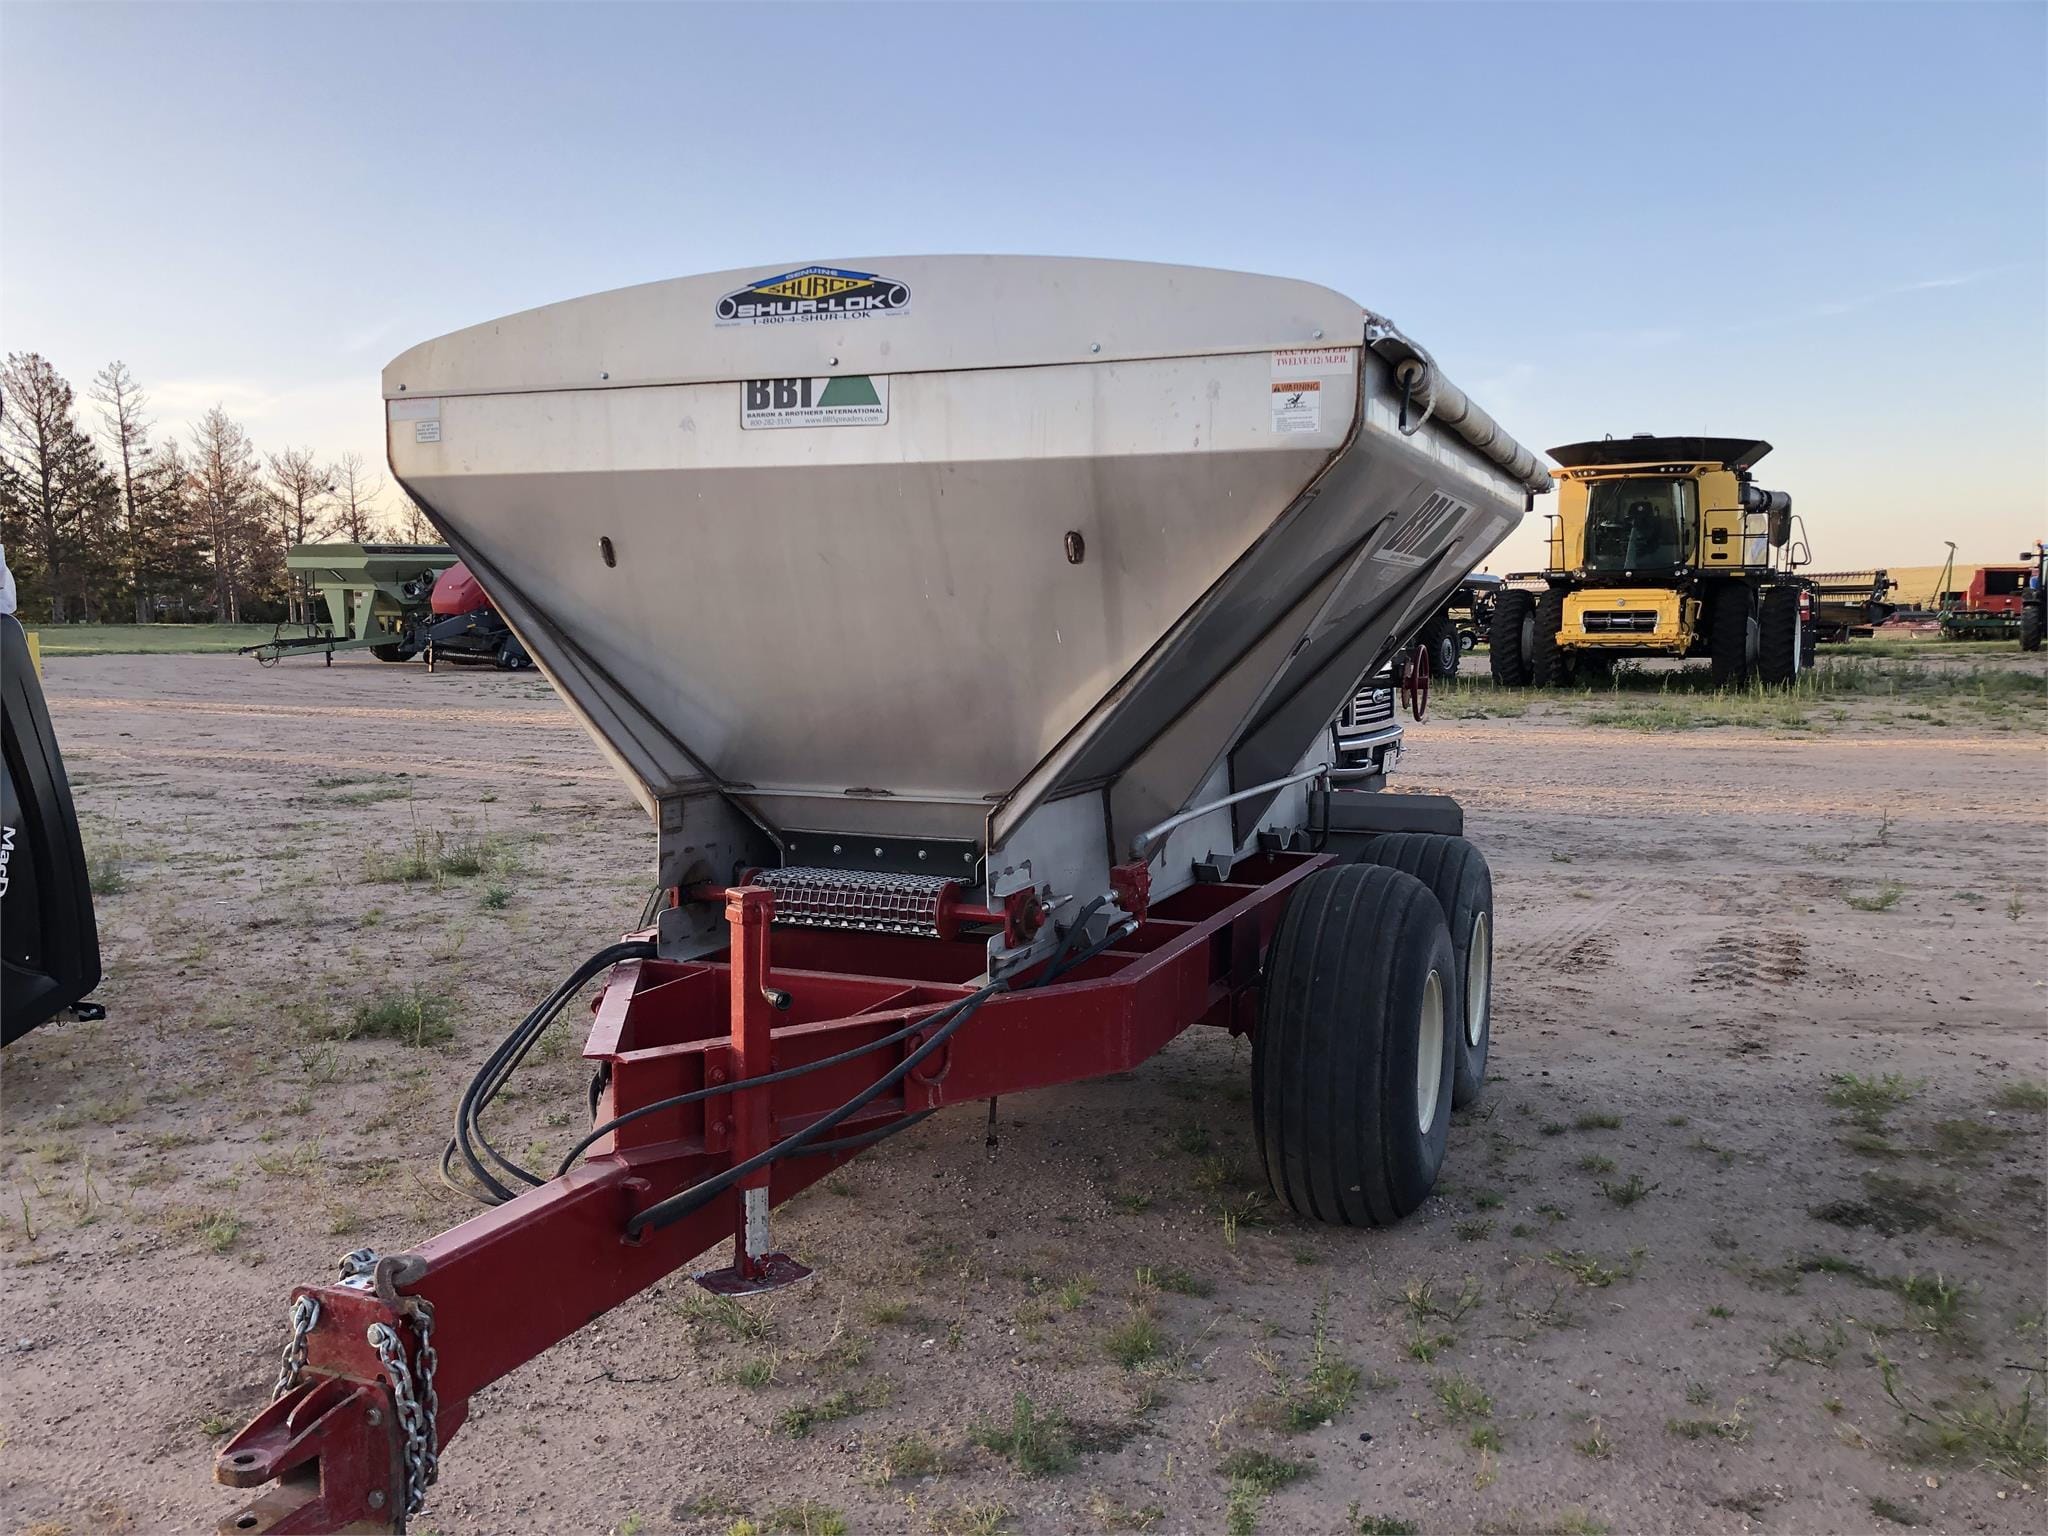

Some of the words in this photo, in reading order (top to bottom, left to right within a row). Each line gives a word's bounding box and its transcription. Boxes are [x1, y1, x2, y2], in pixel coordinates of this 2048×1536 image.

[785, 267, 838, 280] GENUINE
[768, 277, 858, 297] SHURCO
[738, 295, 886, 317] SHUR-LOK
[753, 312, 871, 325] 1-800-4-SHUR-LOK
[1277, 357, 1308, 366] TWELVE
[1281, 382, 1319, 392] WARNING
[747, 378, 812, 410] BBI
